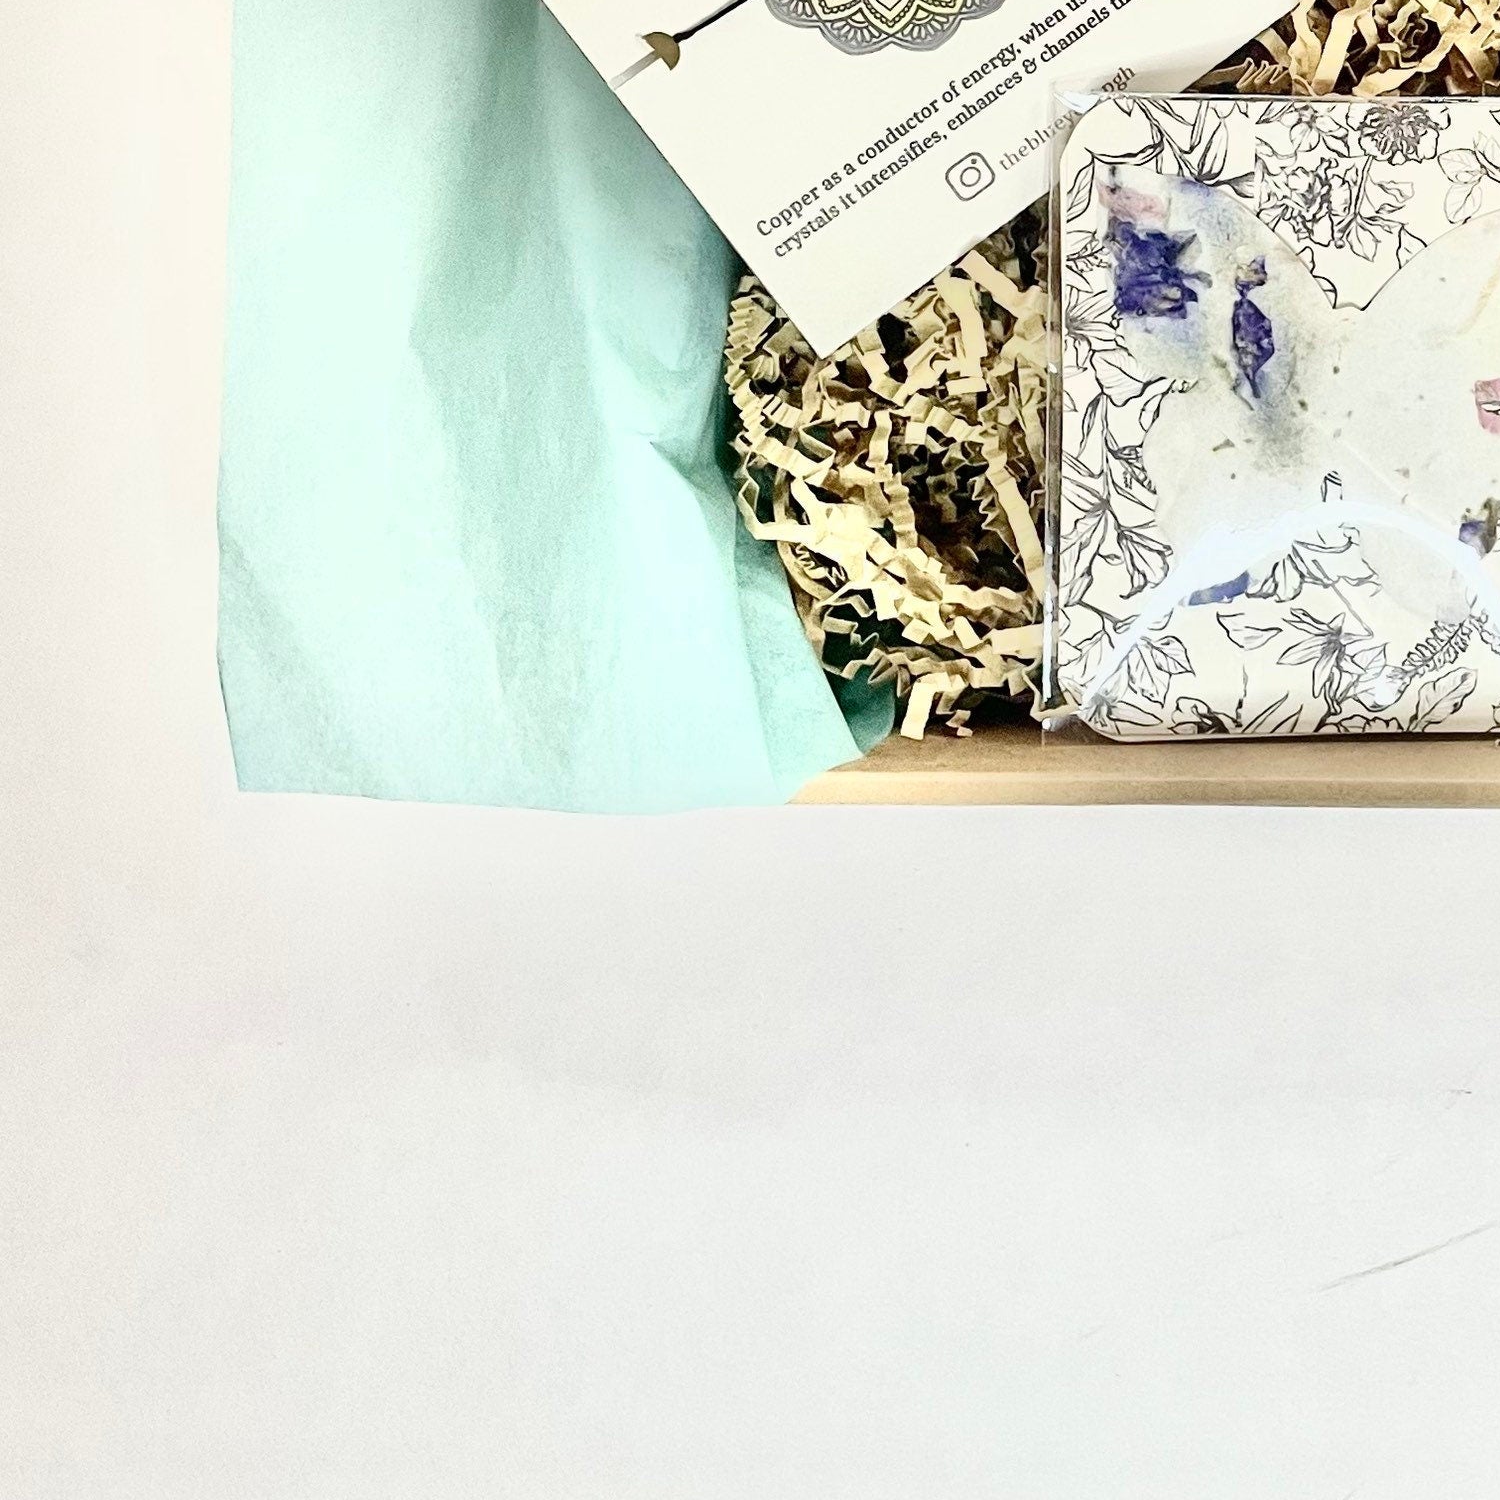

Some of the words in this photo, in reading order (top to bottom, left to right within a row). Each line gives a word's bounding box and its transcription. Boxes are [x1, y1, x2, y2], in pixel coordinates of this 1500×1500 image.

[756, 186, 820, 236] Copper
[821, 171, 842, 191] as
[843, 163, 857, 176] a
[857, 99, 940, 165] conductor
[941, 80, 961, 103] of
[961, 42, 1022, 90] energy,
[1018, 8, 1067, 45] when
[774, 205, 840, 258] crystals
[838, 193, 858, 210] it
[854, 130, 948, 198] intensifies,
[947, 71, 1023, 131] enhances
[1022, 57, 1038, 75] &
[1040, 6, 1110, 63] channels
